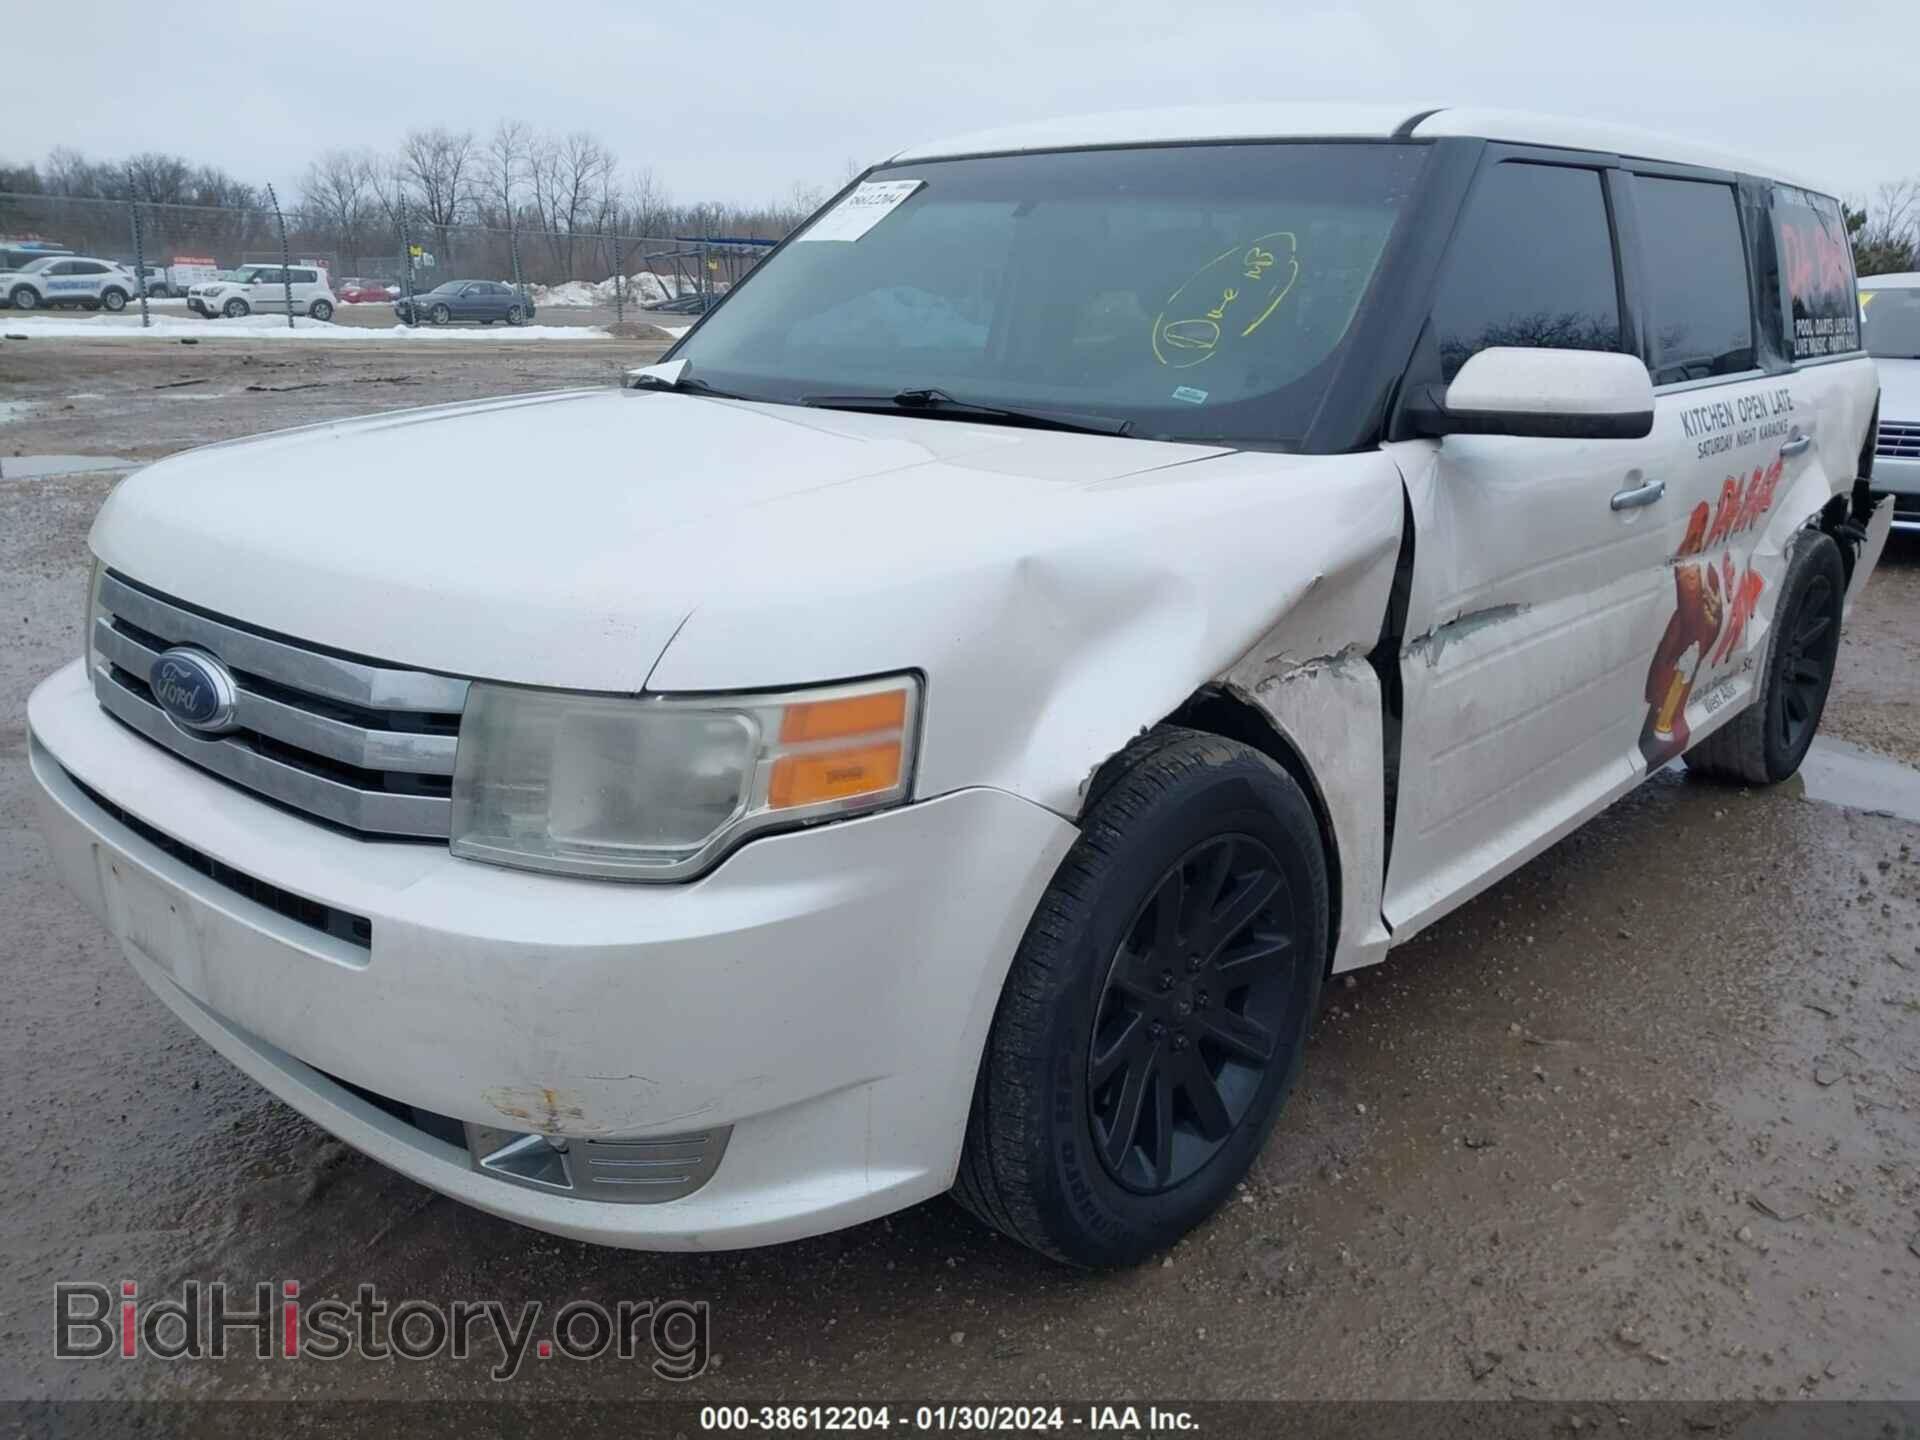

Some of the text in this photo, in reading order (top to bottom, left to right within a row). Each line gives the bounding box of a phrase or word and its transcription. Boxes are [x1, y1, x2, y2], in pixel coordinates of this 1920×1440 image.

[1680, 388, 1795, 439] KITCHEN OPEN LATE
[1697, 419, 1789, 459] SATURDAY NIGHT KARAOKE
[157, 661, 201, 713] Ford
